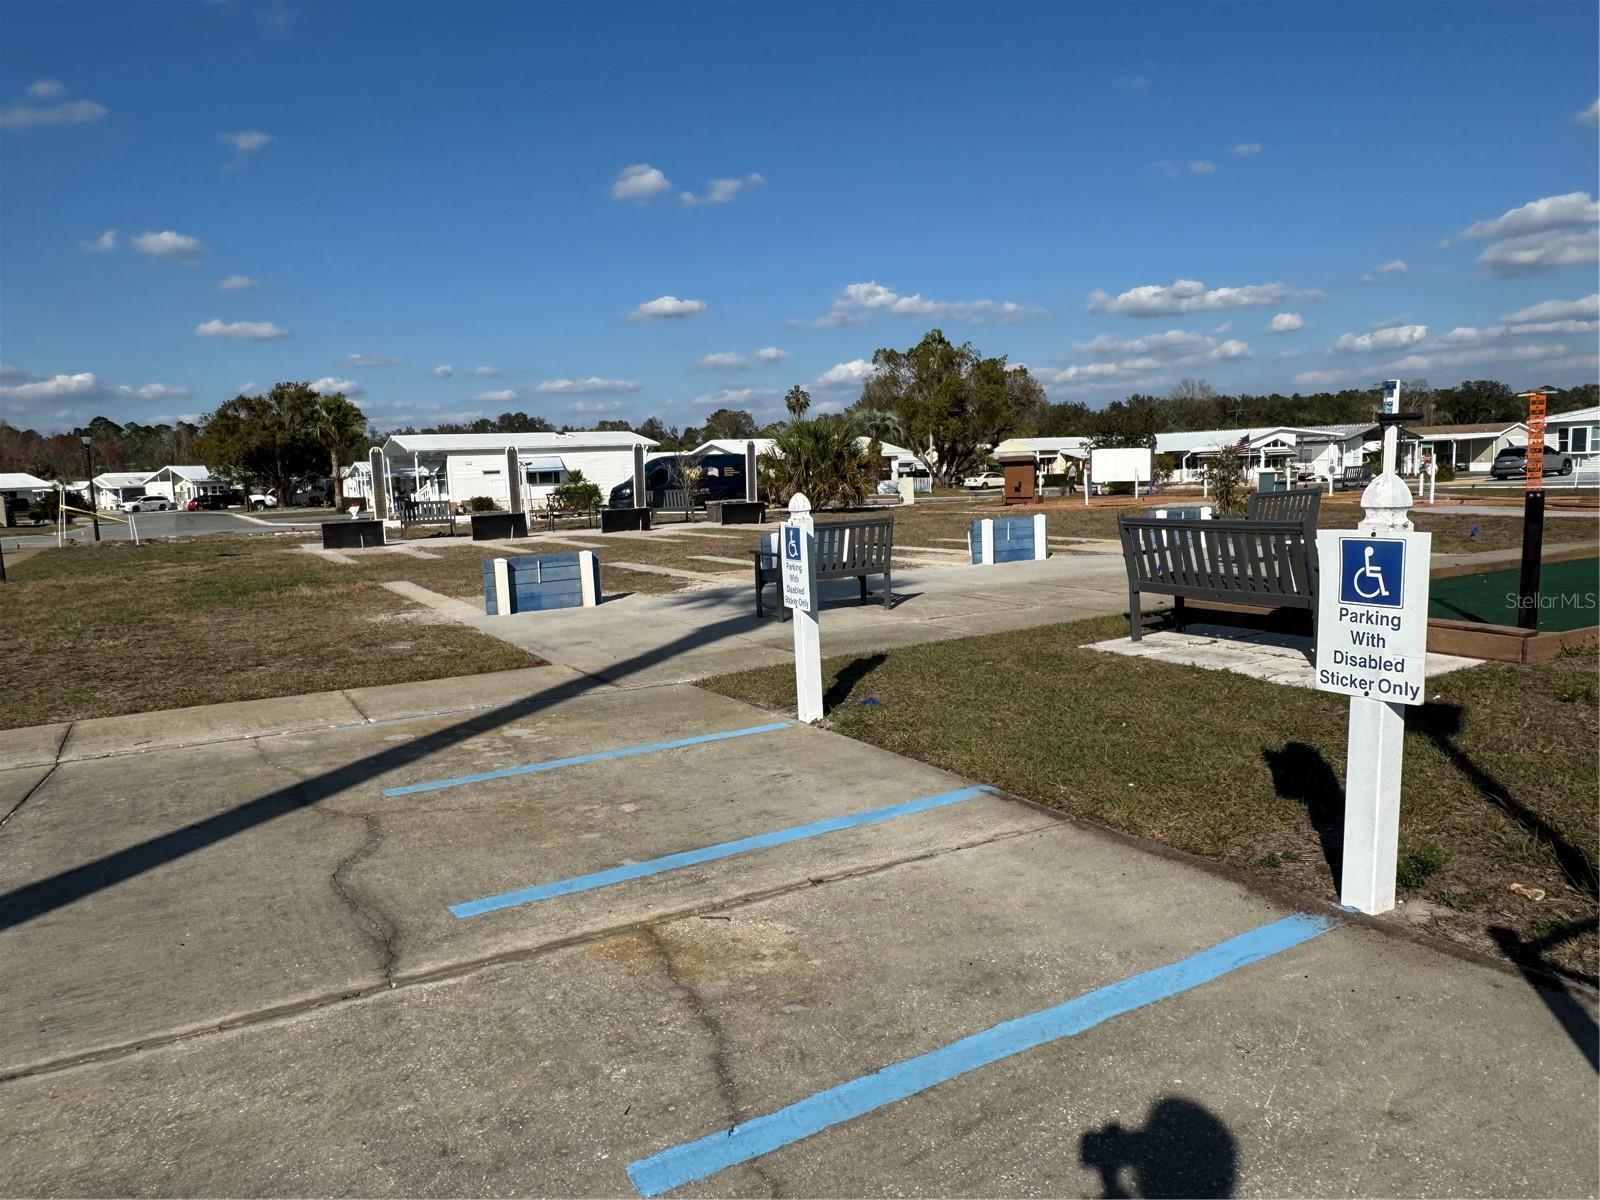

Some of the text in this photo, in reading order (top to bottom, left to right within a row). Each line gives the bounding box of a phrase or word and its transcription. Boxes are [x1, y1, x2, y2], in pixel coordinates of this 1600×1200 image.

[1339, 607, 1402, 631] Parking
[1350, 630, 1387, 649] With
[1333, 650, 1405, 673] Disabled
[1319, 670, 1421, 701] Sticker Only
